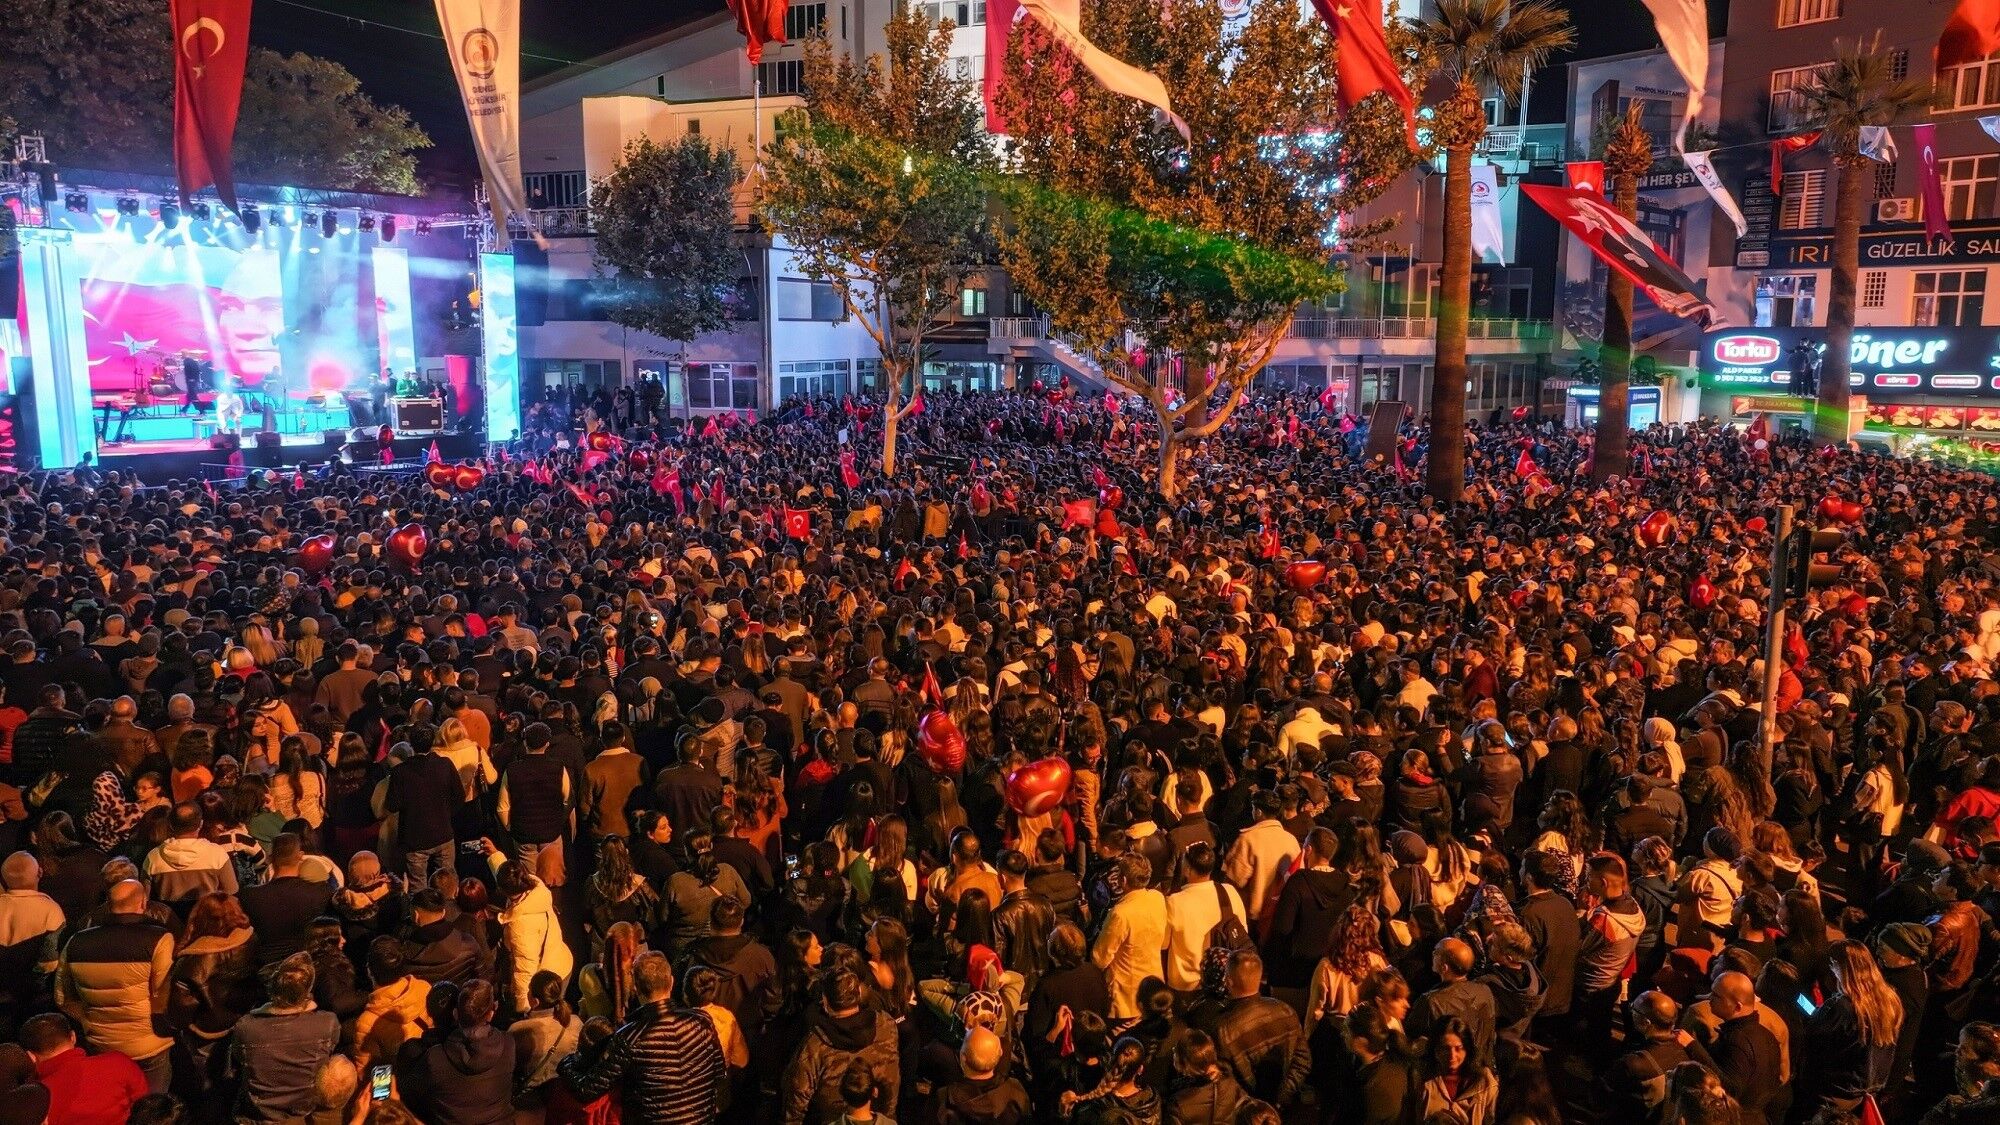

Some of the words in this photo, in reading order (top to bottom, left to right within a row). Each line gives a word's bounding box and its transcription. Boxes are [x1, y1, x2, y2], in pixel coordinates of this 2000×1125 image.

[1650, 174, 1673, 187] HER
[1675, 172, 1696, 188] ŞEY
[1867, 238, 1956, 259] GÜZELLİK
[1722, 342, 1772, 358] Torku
[1820, 335, 1948, 368] öner
